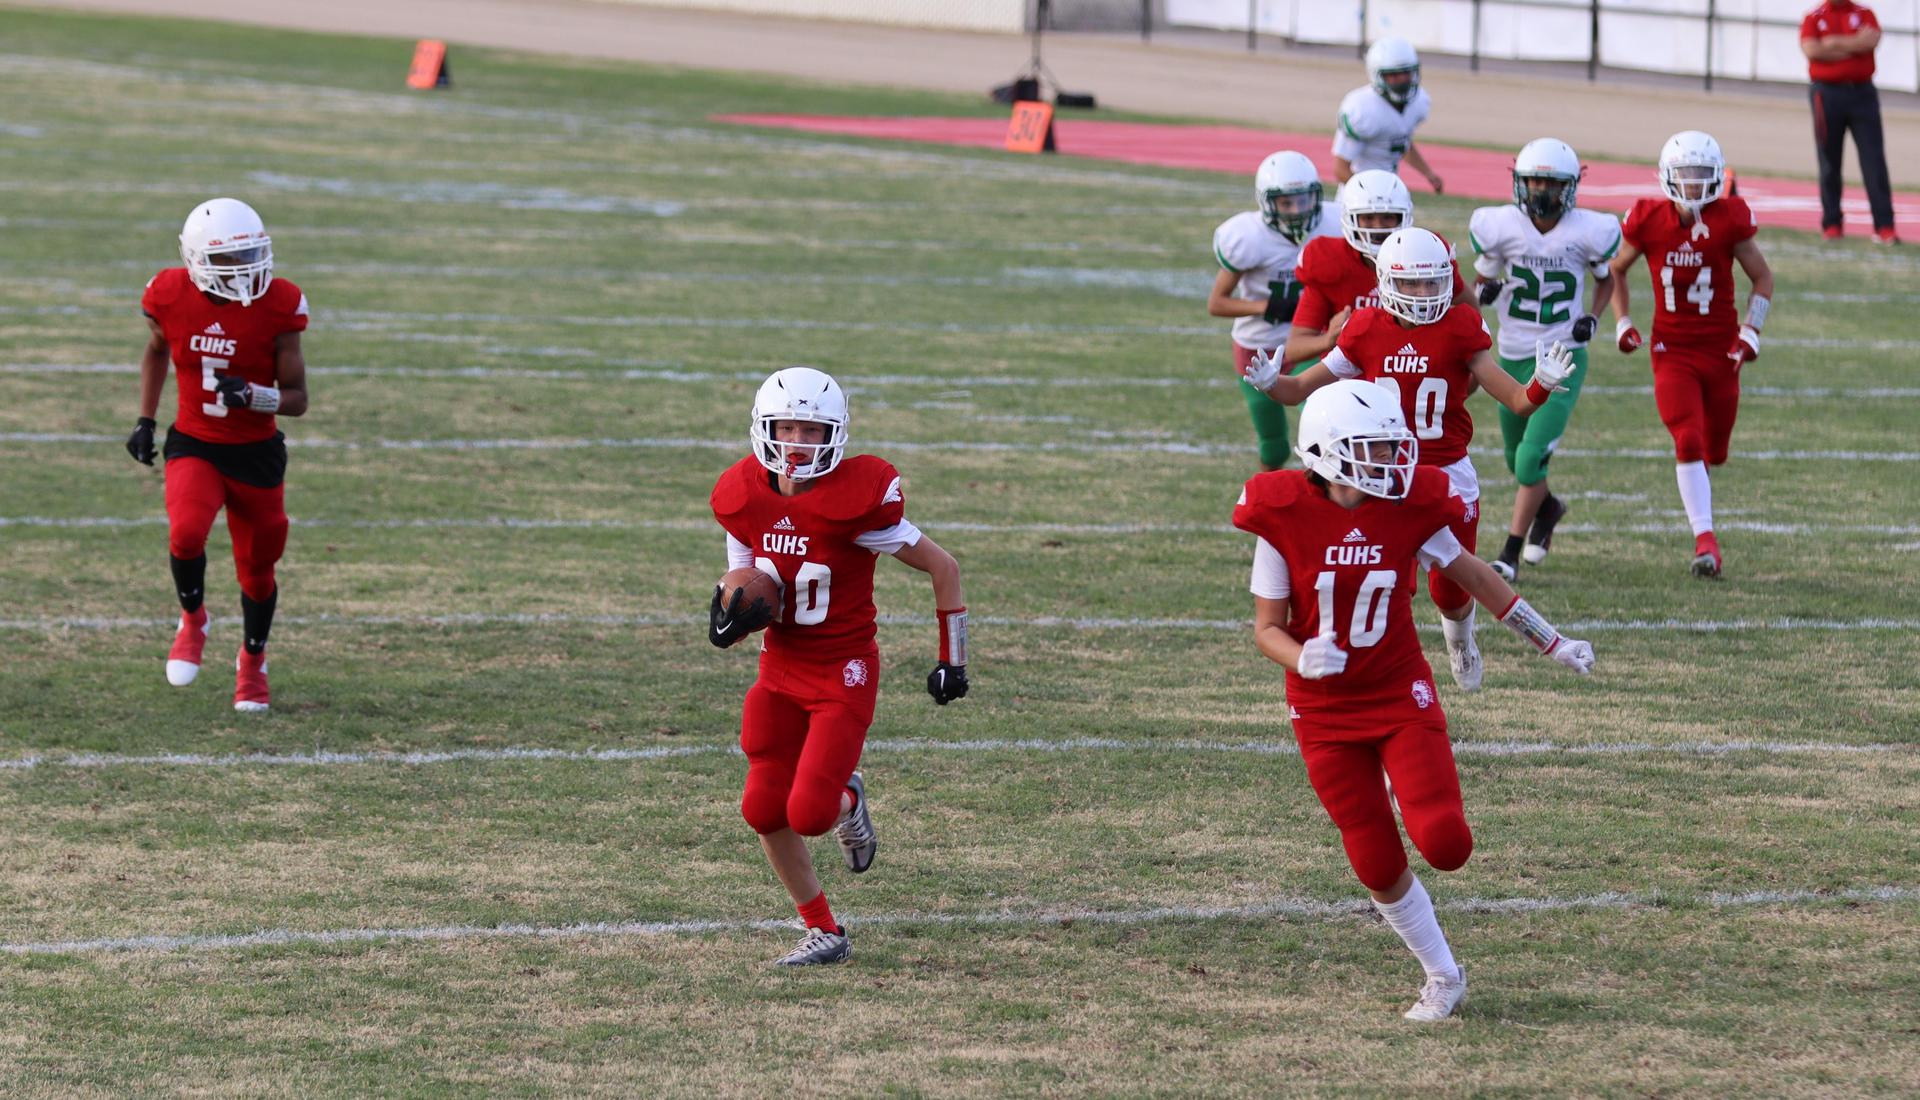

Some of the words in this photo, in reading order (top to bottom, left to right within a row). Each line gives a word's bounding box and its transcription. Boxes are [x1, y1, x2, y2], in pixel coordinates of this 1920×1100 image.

[1666, 251, 1703, 267] CUHS
[1508, 264, 1577, 324] 22
[1660, 266, 1714, 315] 14
[1355, 295, 1382, 310] CU
[190, 335, 237, 356] CUHS
[1383, 356, 1429, 373] CUHS
[201, 356, 229, 417] 5
[773, 523, 795, 531] adidas
[763, 533, 809, 556] CUHS
[1325, 545, 1383, 565] CUHS
[1314, 570, 1397, 648] 10
